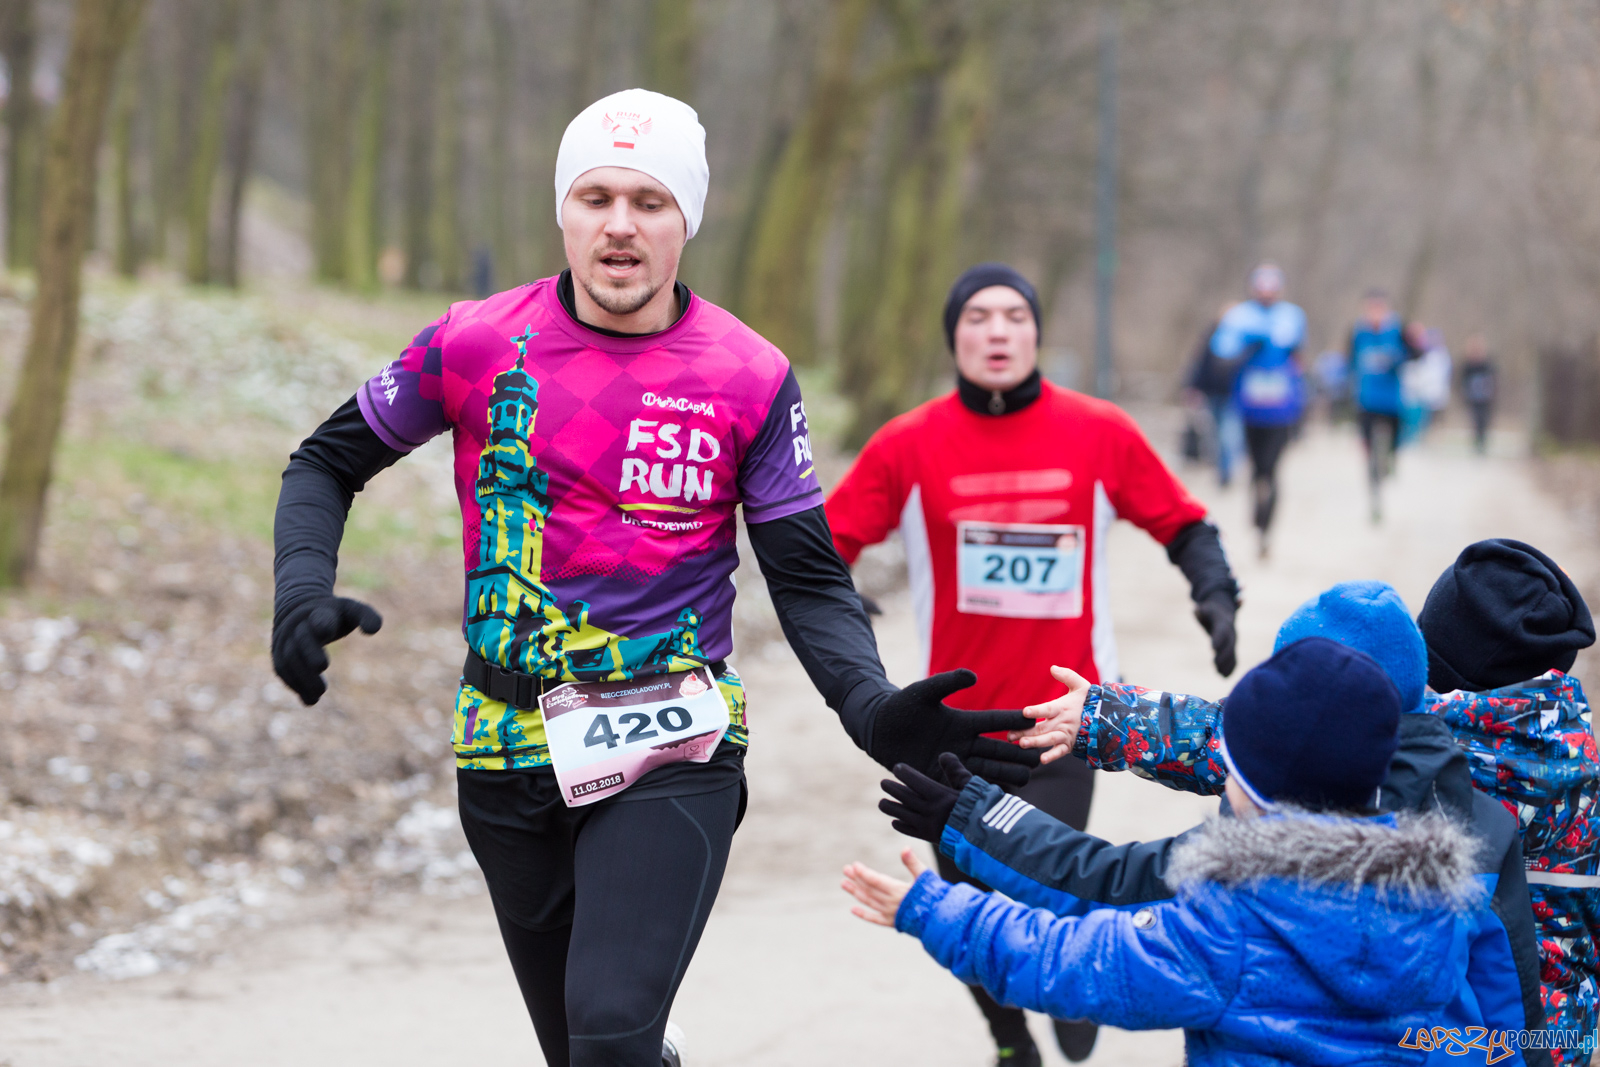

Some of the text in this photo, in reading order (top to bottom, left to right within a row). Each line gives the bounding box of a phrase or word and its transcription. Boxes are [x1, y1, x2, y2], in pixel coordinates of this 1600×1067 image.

[625, 418, 721, 463] FSD
[618, 457, 715, 503] RUN
[984, 553, 1058, 584] 207
[600, 682, 672, 699] BIEGCZEKOLADOWY.PL
[583, 706, 693, 750] 420
[573, 775, 622, 796] 11.02.2018
